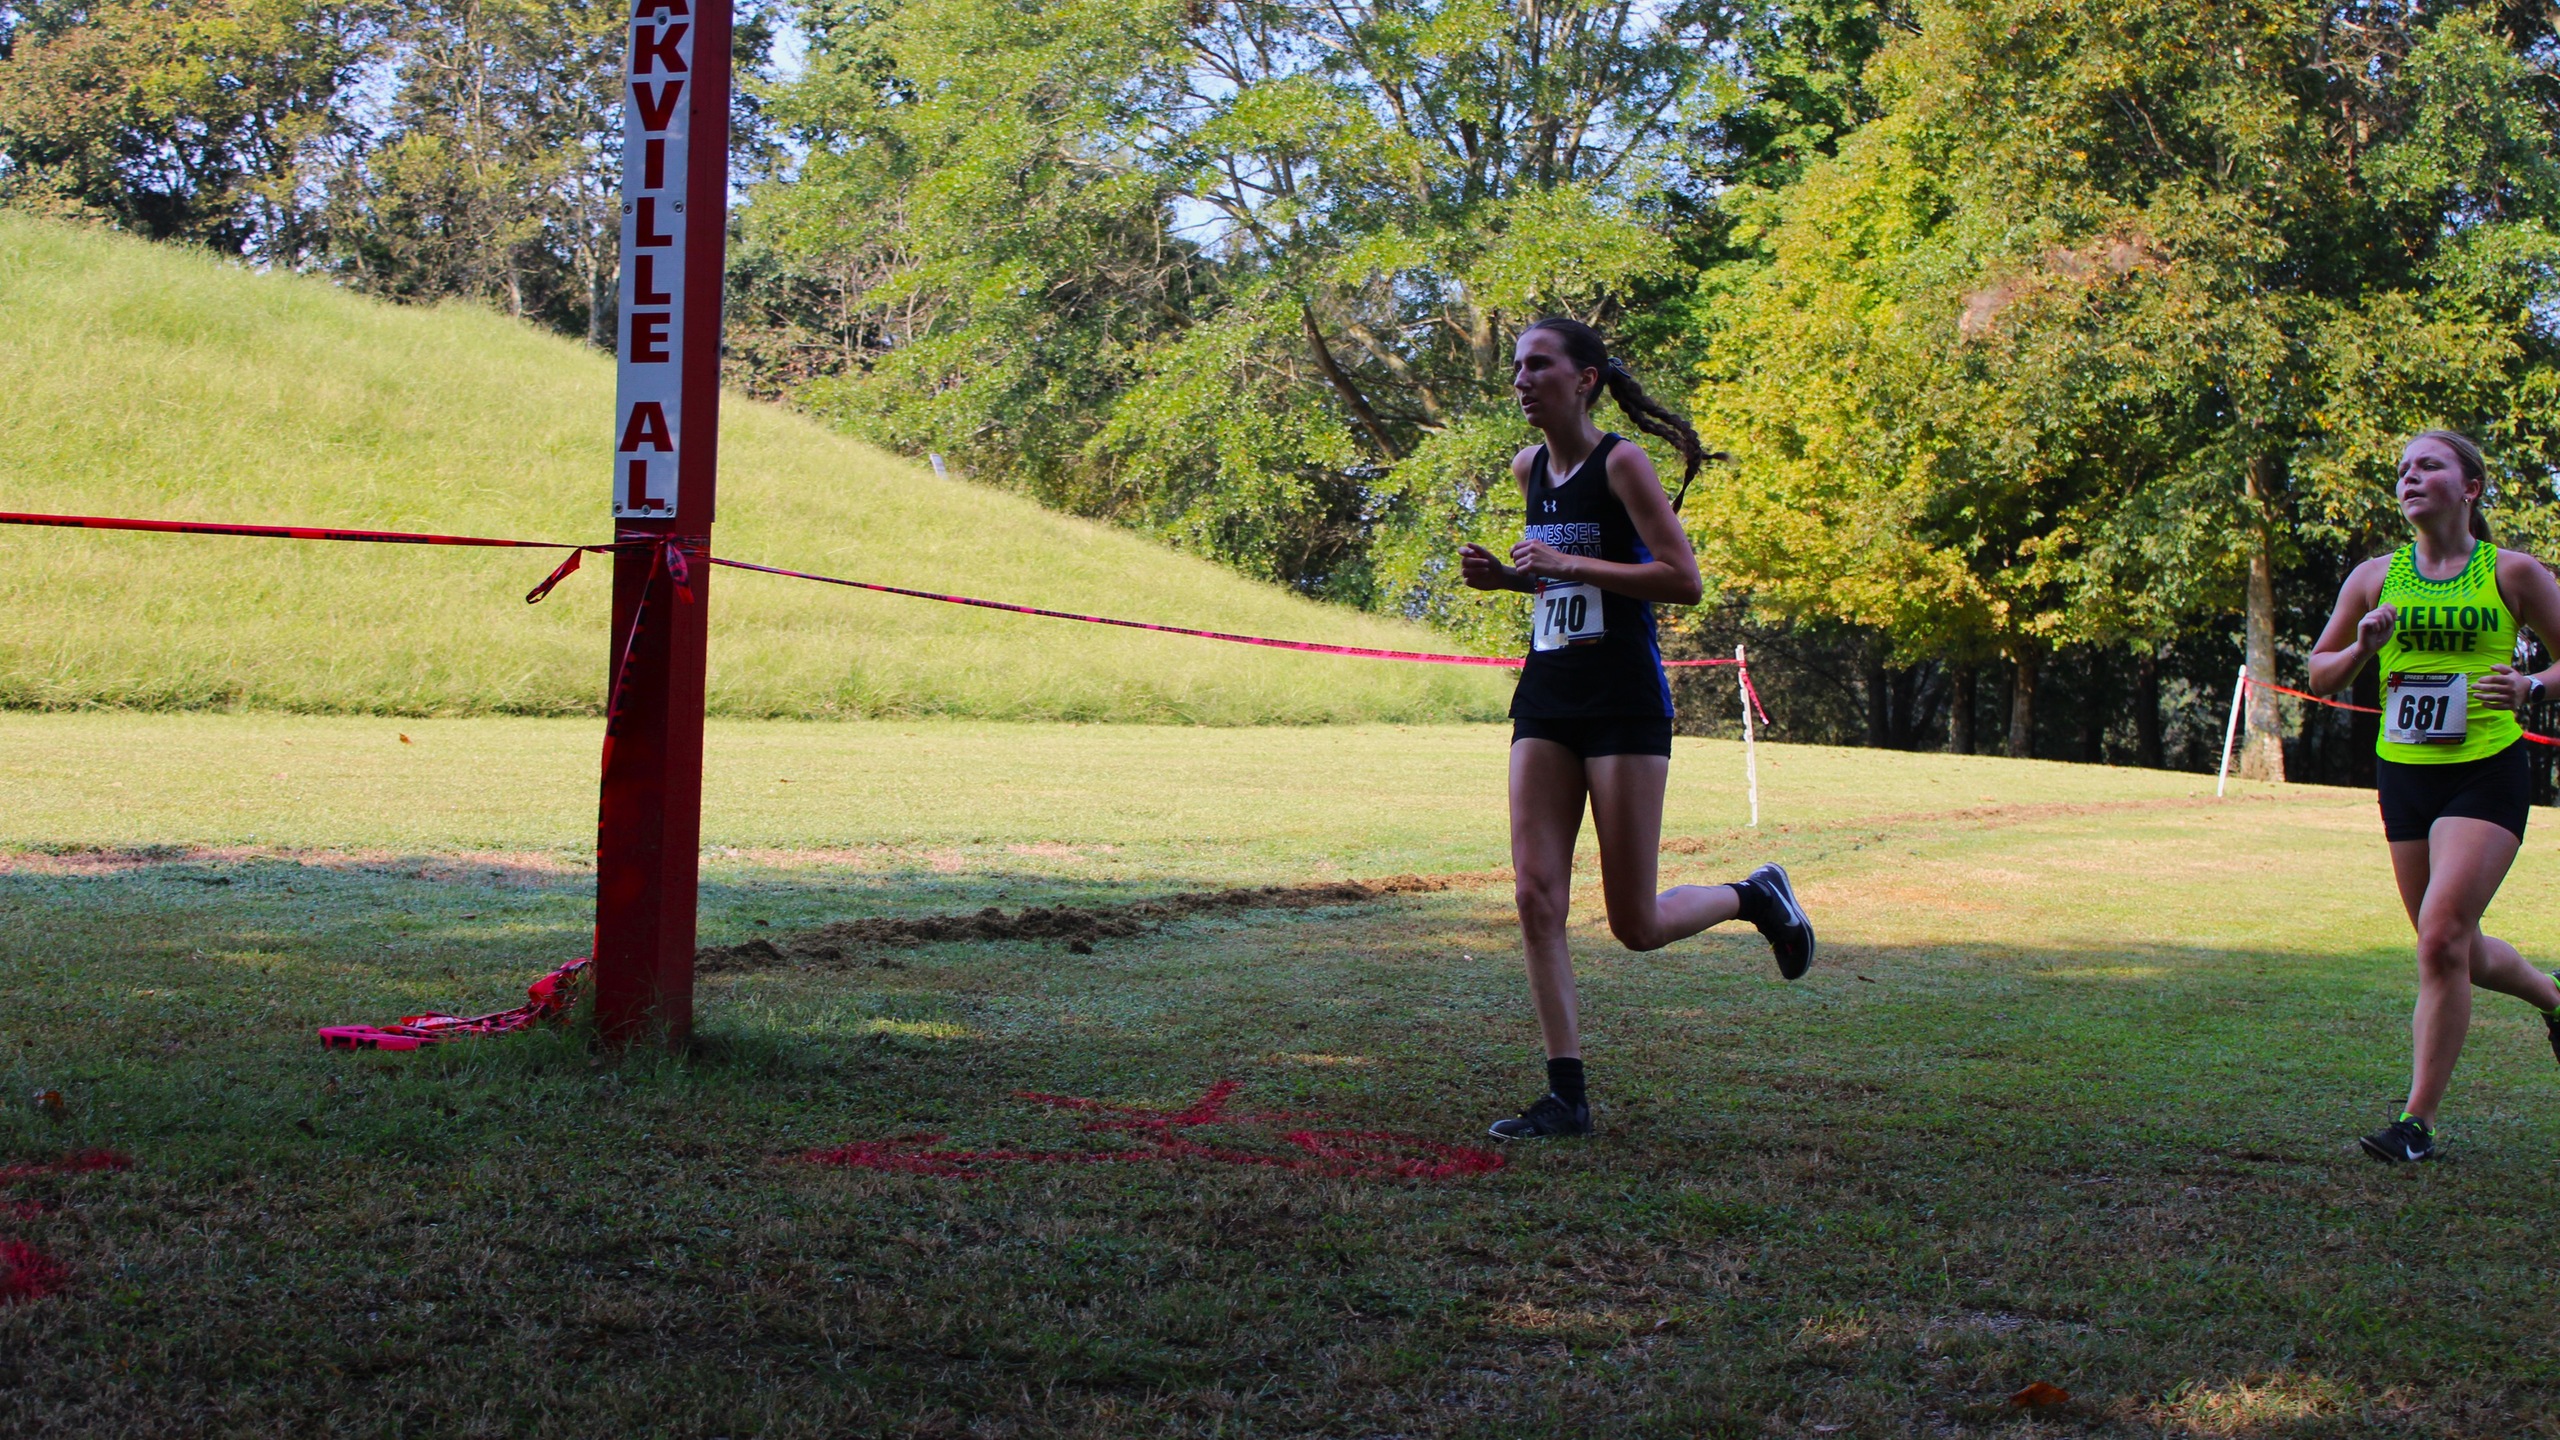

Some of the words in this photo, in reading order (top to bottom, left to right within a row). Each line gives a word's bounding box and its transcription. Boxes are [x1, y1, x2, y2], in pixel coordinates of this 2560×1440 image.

[618, 401, 674, 509] AL
[1525, 523, 1601, 545] ENNESSEE
[1544, 594, 1587, 636] 740
[2394, 606, 2499, 632] HELTON
[2396, 631, 2478, 653] STATE
[2398, 694, 2450, 731] 681
